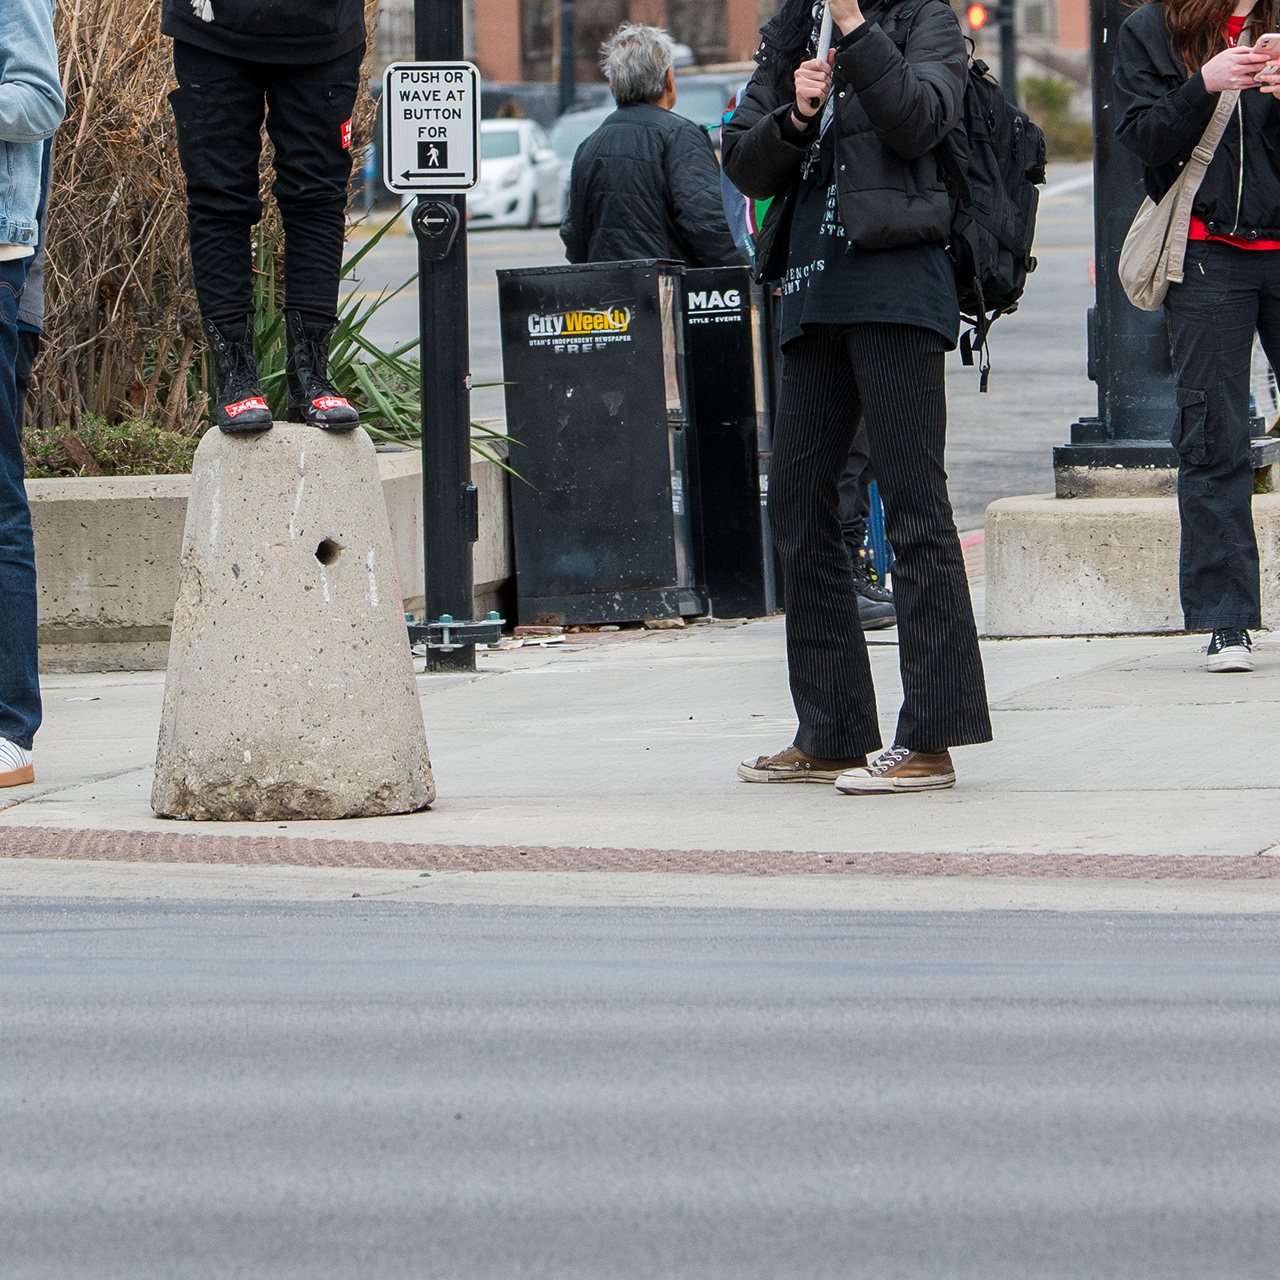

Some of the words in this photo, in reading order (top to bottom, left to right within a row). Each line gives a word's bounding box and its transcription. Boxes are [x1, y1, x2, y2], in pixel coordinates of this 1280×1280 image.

[401, 72, 440, 84] PUSH
[444, 72, 463, 84] OR
[399, 90, 441, 102] WAVE
[446, 90, 465, 102] AT
[403, 108, 462, 120] BUTTON
[418, 126, 447, 138] FOR
[688, 290, 741, 310] MAG
[528, 312, 564, 336] City
[566, 308, 629, 333] Weekly
[715, 315, 742, 323] EVENTS
[529, 338, 551, 346] UTAH'S
[552, 336, 593, 345] INDEPENDENT
[595, 334, 632, 344] NEWSPAPER
